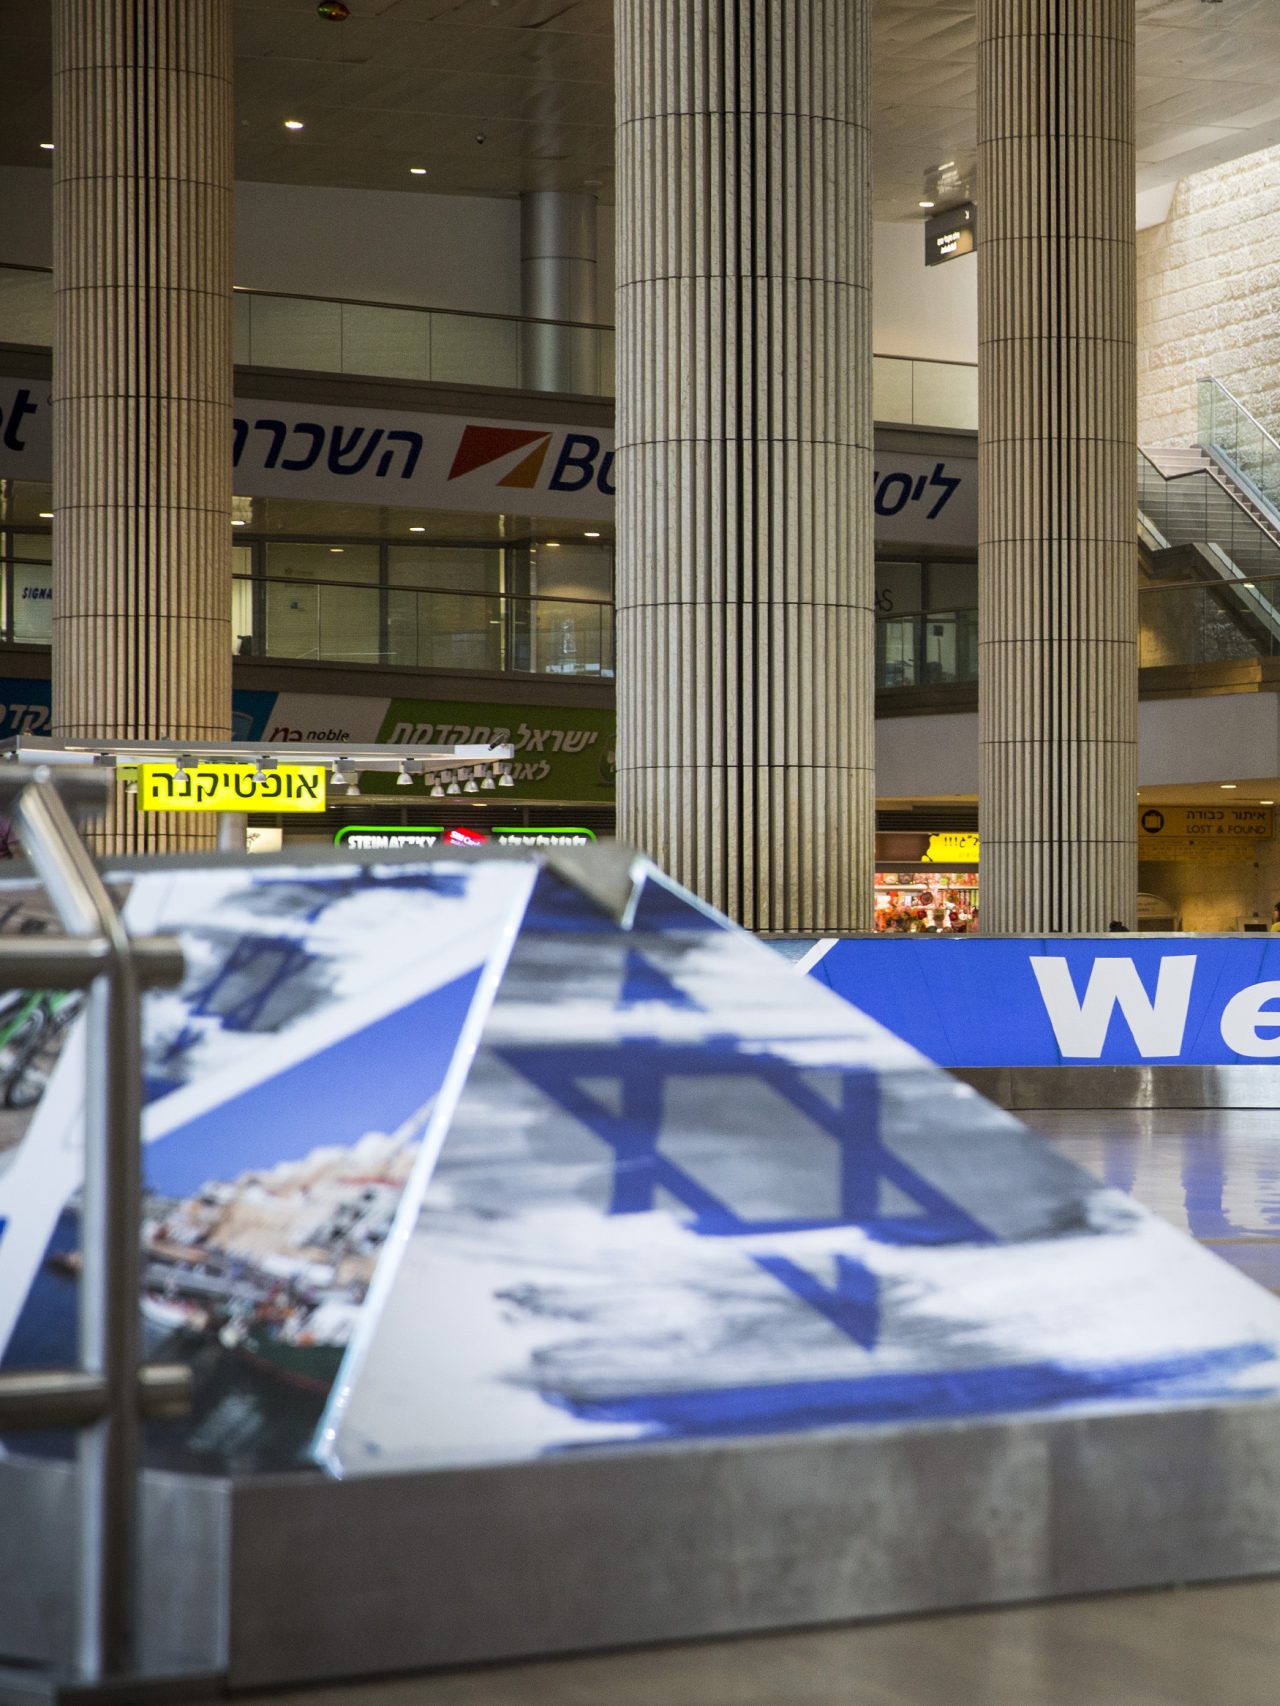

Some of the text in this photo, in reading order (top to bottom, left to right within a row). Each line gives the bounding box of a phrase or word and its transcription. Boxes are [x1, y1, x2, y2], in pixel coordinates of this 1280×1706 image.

[874, 463, 962, 519] ליס
[517, 723, 597, 752] ישראל
[152, 772, 319, 802] אופטיקנה
[1186, 810, 1266, 820] איתור כבודה
[1186, 825, 1266, 834] LOST & FOUND
